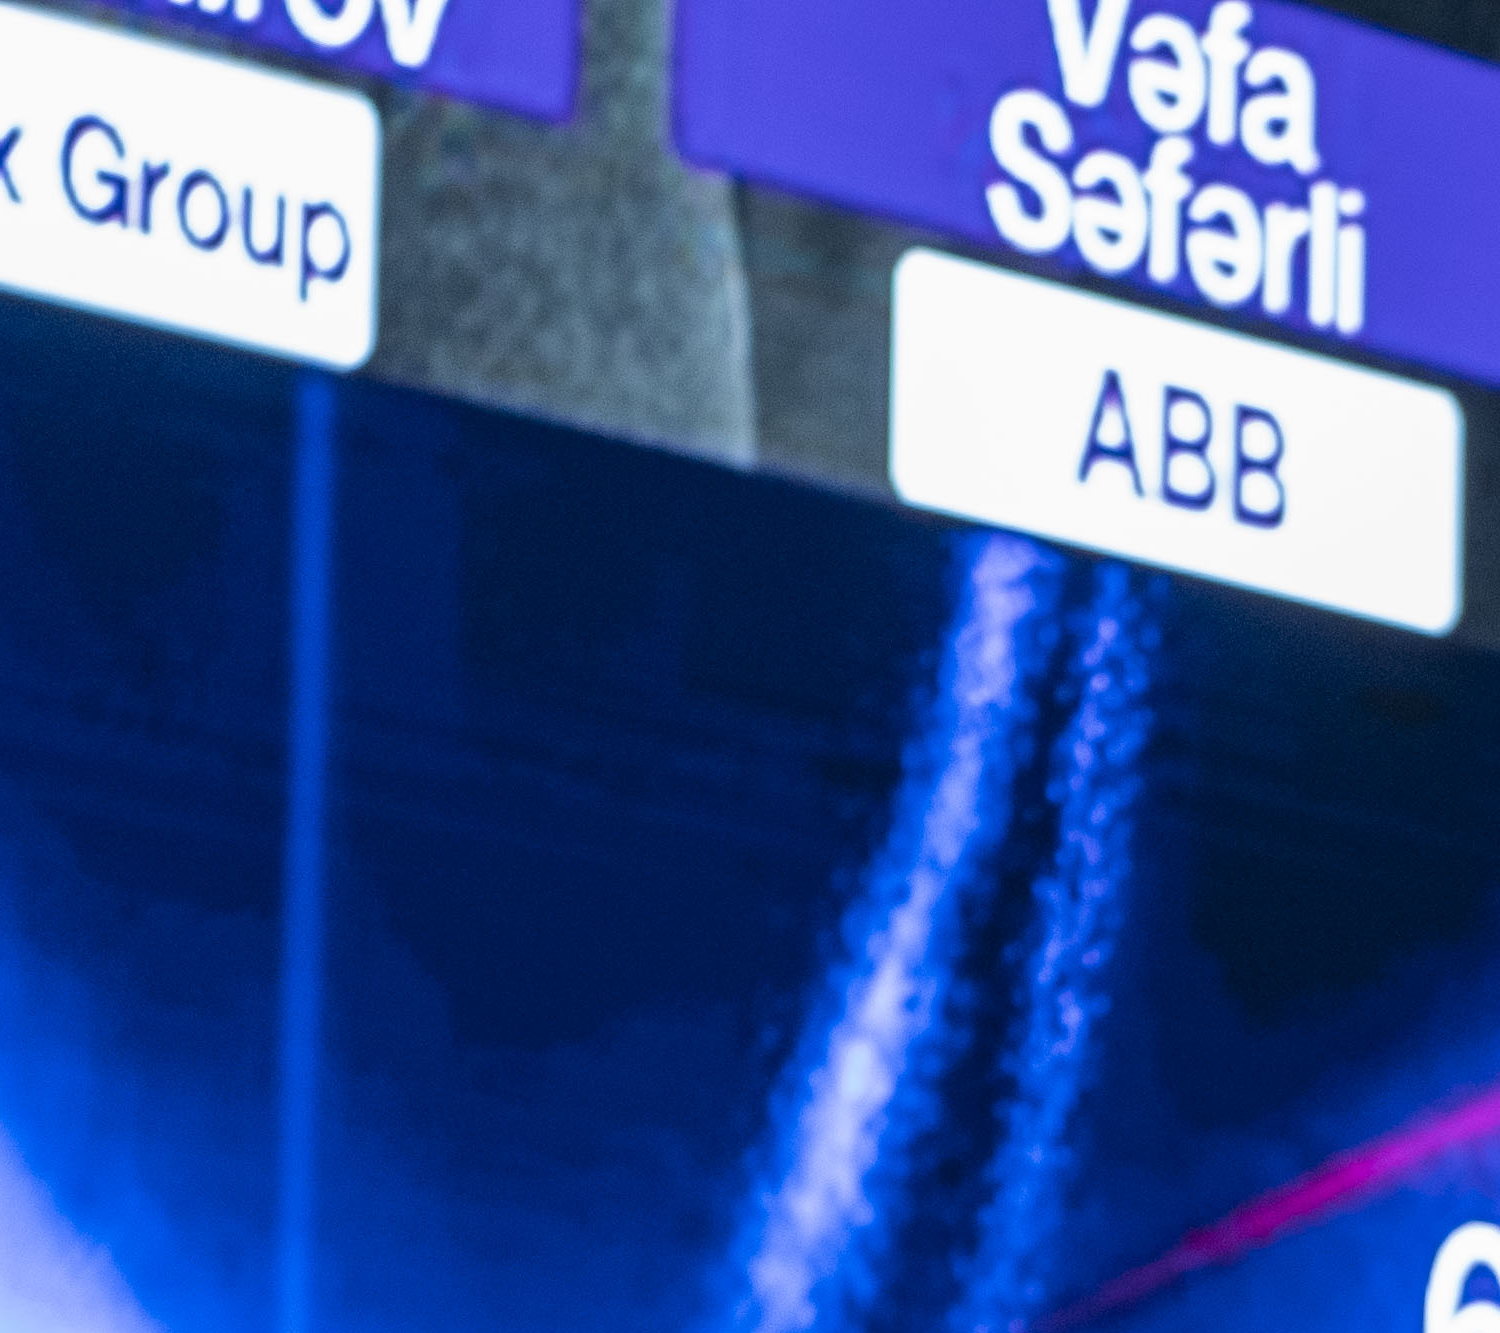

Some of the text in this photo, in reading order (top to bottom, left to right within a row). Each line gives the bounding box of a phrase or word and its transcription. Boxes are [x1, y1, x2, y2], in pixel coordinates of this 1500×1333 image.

[1046, 0, 1319, 175] Vəfa
[59, 115, 351, 303] Group
[985, 89, 1365, 334] Səfərli
[1077, 368, 1287, 529] ABB
